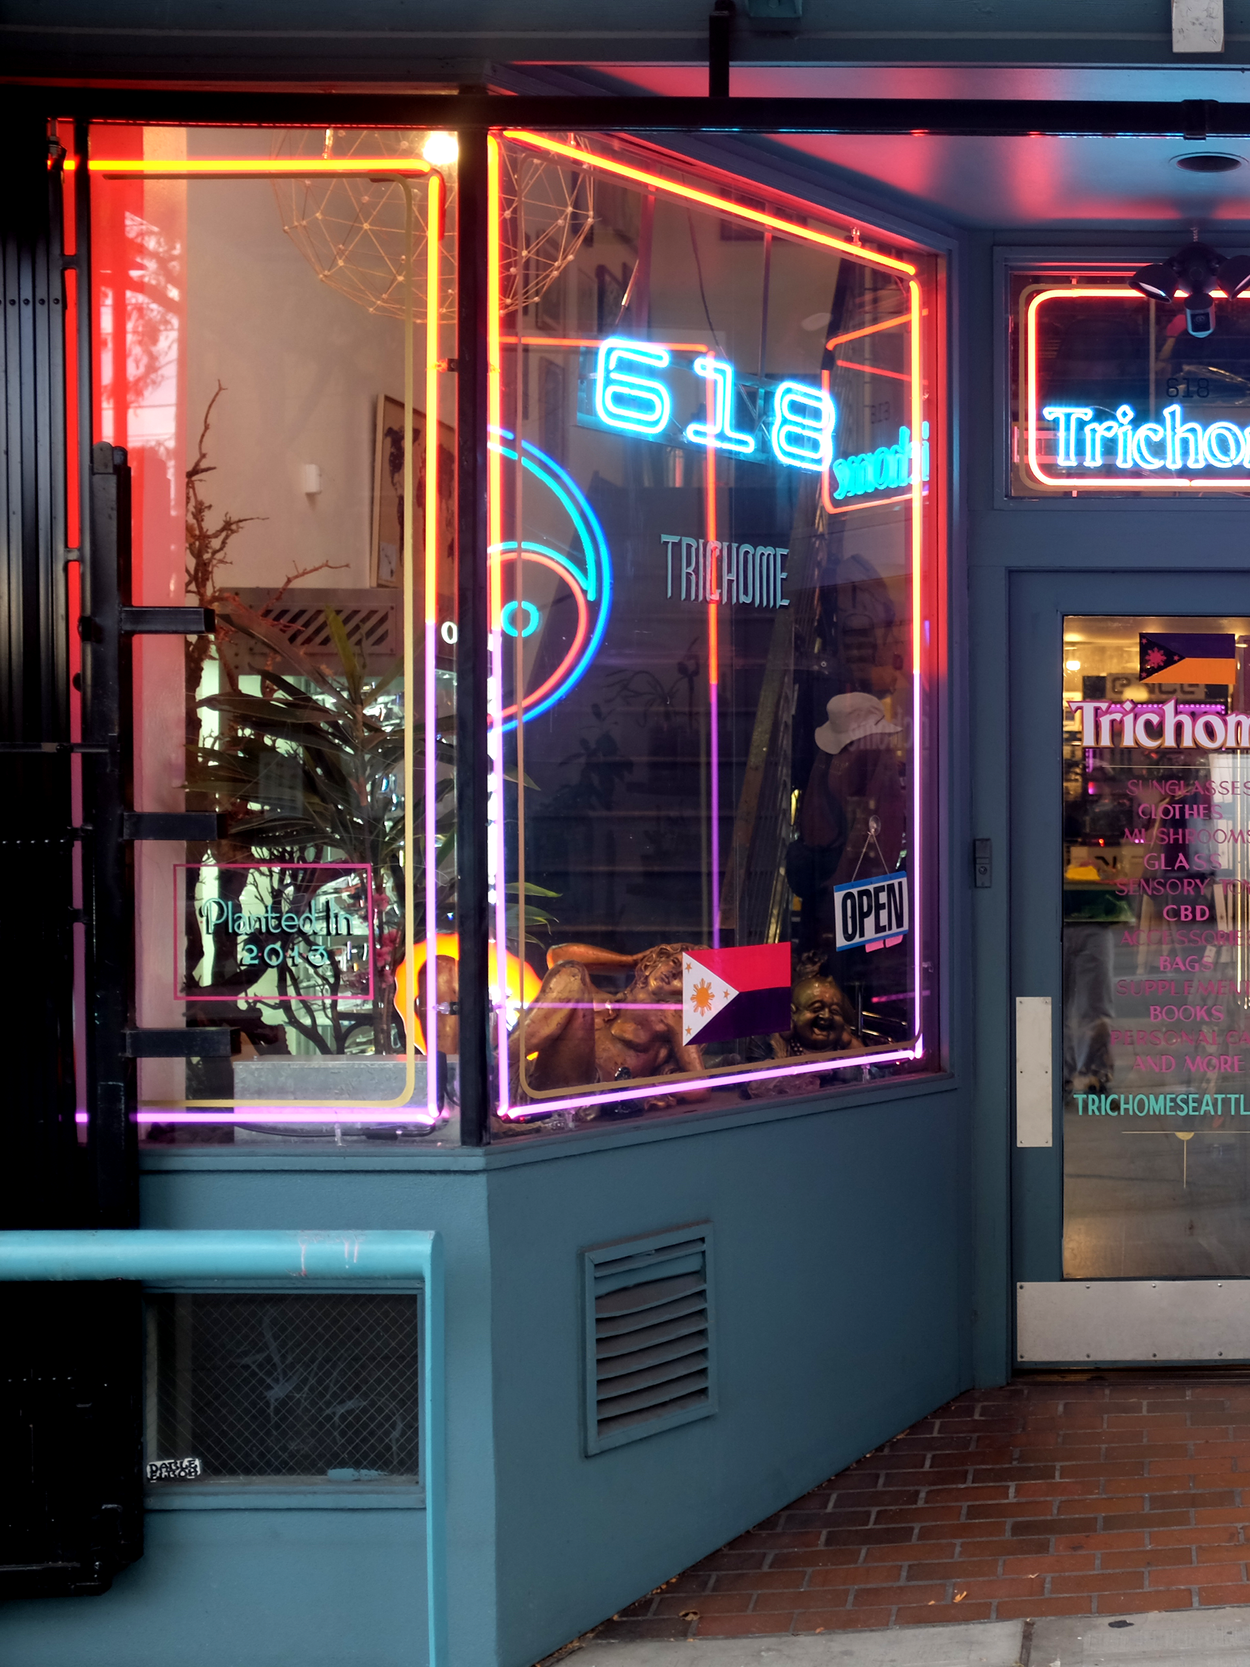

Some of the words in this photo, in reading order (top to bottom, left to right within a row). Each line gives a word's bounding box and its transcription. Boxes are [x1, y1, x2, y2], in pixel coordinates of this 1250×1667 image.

[1166, 378, 1210, 399] 618
[596, 336, 836, 473] 618
[660, 533, 790, 609] TRICHOME
[1138, 803, 1224, 821] CLOTHES
[1143, 852, 1223, 871] GLASS
[1114, 878, 1211, 897] SENSORY
[202, 897, 318, 935] Planted
[327, 897, 354, 934] In
[841, 881, 904, 943] OPEN
[1162, 905, 1211, 922] CBD
[1159, 955, 1215, 973] BAGS
[1149, 1004, 1225, 1023] BOOKS
[1110, 1029, 1220, 1047] PERSONAL
[1132, 1054, 1176, 1073] AND
